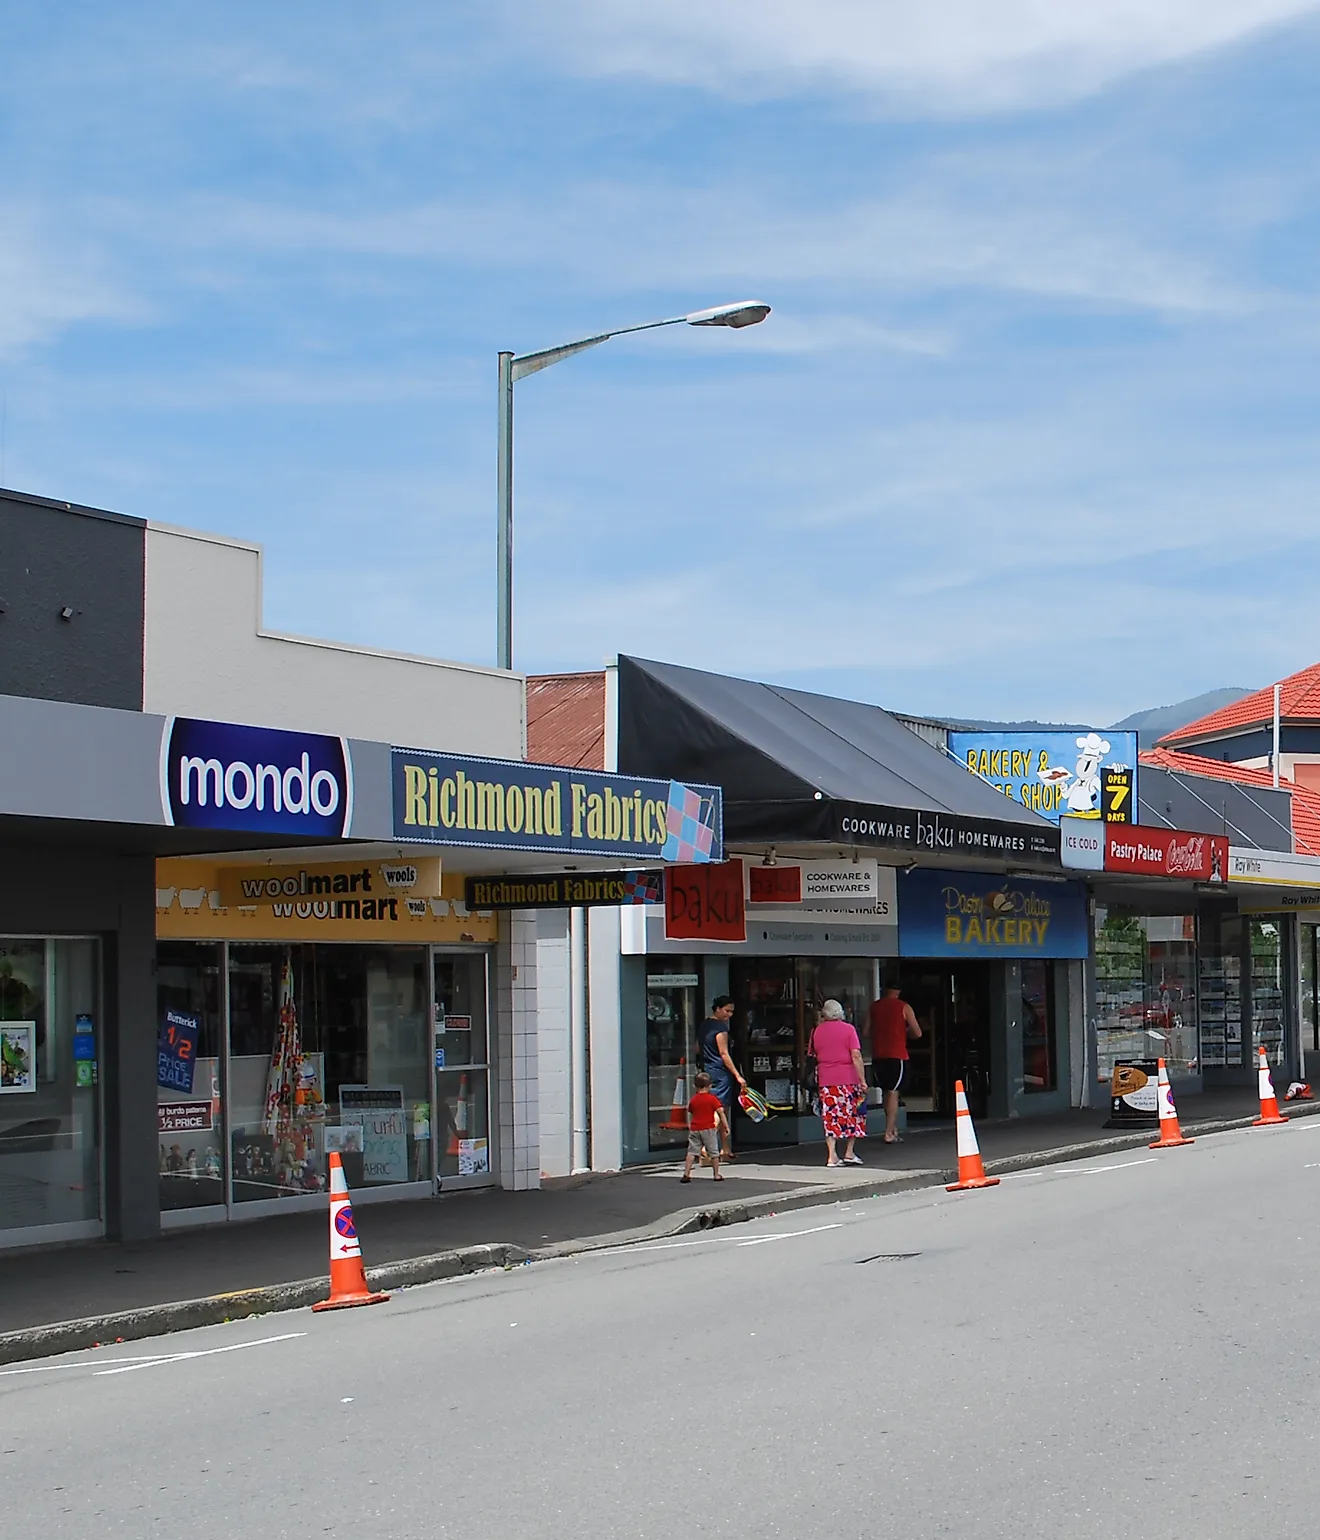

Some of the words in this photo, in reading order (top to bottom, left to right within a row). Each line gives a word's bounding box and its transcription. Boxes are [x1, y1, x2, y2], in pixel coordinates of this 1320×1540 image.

[967, 748, 1033, 779] BAKERY
[180, 751, 339, 817] mondo
[1107, 774, 1128, 785] OPEN
[403, 764, 564, 837] Richmond
[571, 783, 668, 846] Fabrics
[1020, 782, 1063, 812] SHOP
[1106, 785, 1130, 811] 7
[1107, 813, 1127, 823] DAYS
[841, 816, 911, 840] COOKWARE
[916, 812, 954, 849] baku
[958, 831, 1026, 850] HOMEWARES
[1065, 836, 1077, 848] ICE
[1079, 838, 1099, 851] COLD
[1111, 840, 1137, 863] Pastry
[1138, 844, 1163, 862] Palace
[386, 866, 415, 883] wools
[1235, 857, 1246, 874] Ray
[1247, 860, 1261, 874] White
[241, 868, 372, 898] woolmart
[806, 872, 861, 882] COOKWARE
[863, 872, 871, 880] &
[474, 880, 559, 904] Richmond
[564, 877, 625, 902] Fabrics
[669, 864, 741, 929] baku
[807, 884, 871, 894] HOMEWARES
[272, 898, 399, 921] woolmart
[408, 901, 426, 913] wools
[941, 886, 984, 923] Pastry
[1281, 896, 1299, 908] Ray
[945, 915, 1049, 946] BAKERY
[167, 1011, 198, 1029] Butterick
[159, 1067, 191, 1088] SALE
[175, 1117, 202, 1128] PRICE
[364, 1162, 391, 1175] ABRIC
